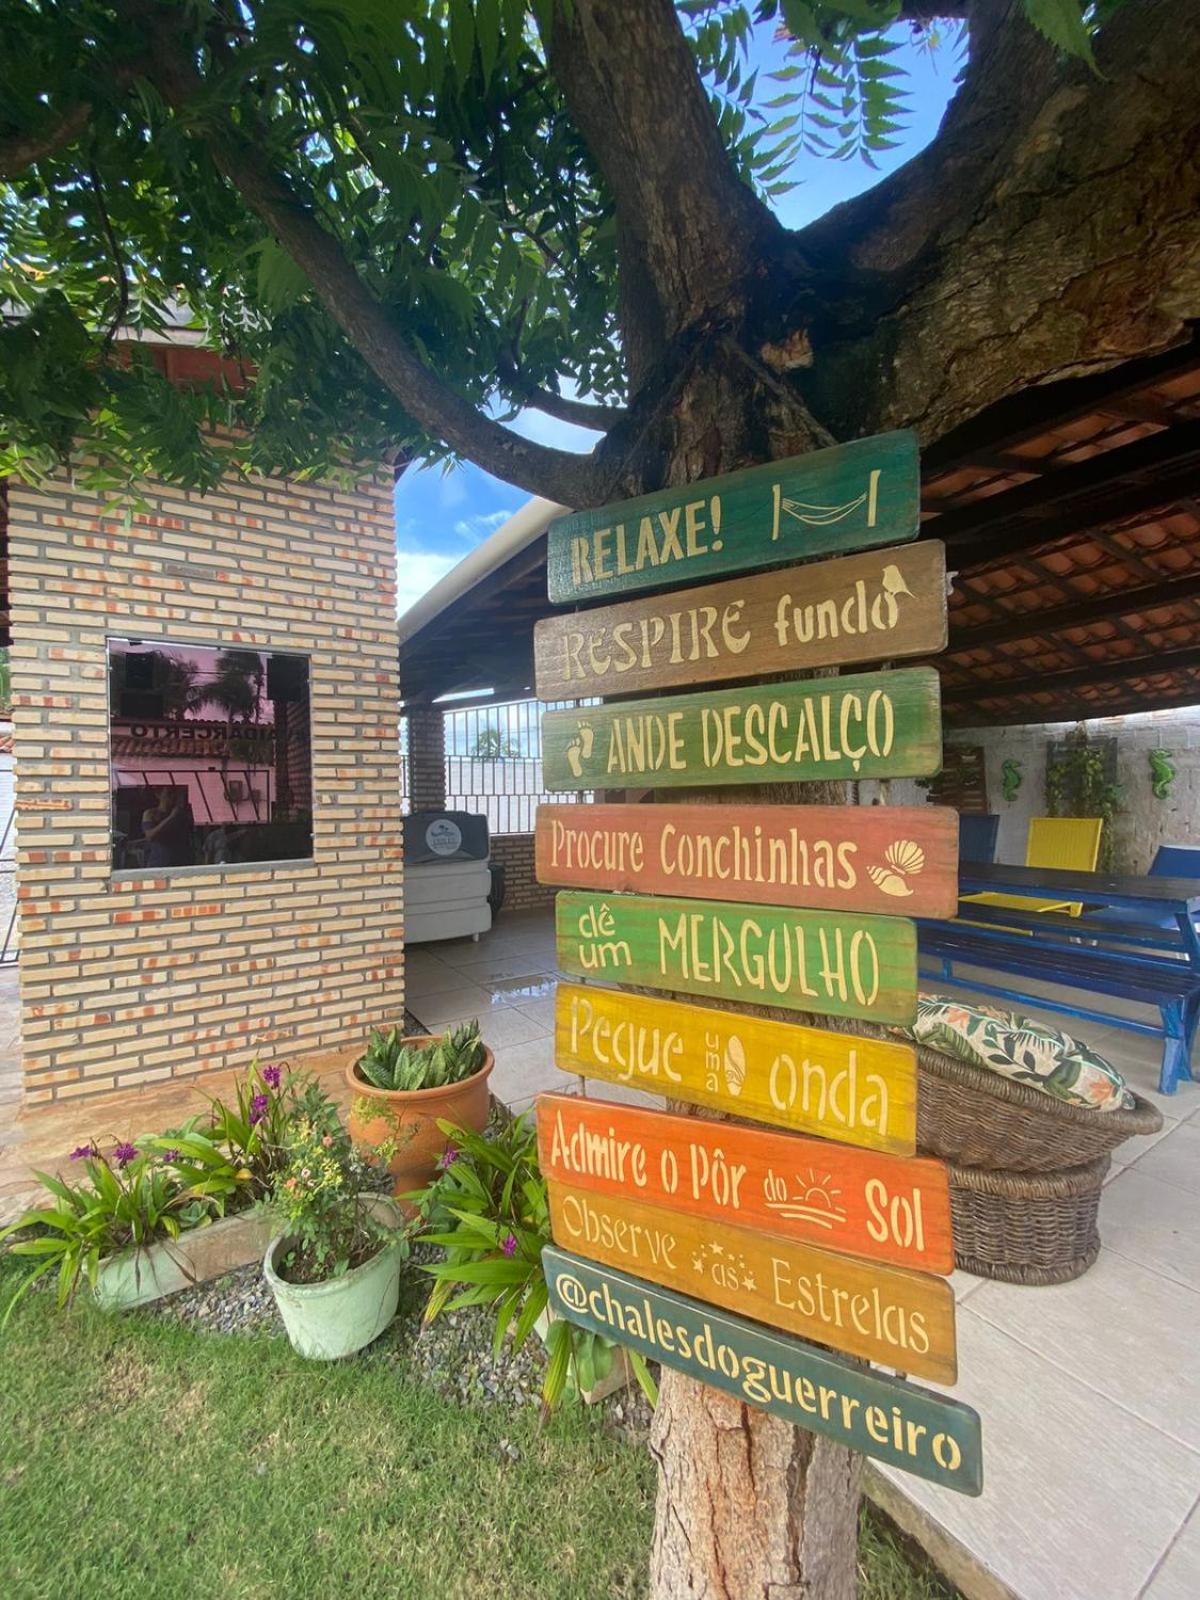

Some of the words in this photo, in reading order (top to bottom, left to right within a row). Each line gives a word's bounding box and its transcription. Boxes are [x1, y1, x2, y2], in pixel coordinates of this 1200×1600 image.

[571, 495, 724, 585] RELAXE!
[562, 600, 751, 681] RESPIRE
[774, 580, 899, 646] fundo
[607, 712, 687, 773] ANDE
[702, 690, 895, 771] DESCALÇO
[551, 820, 644, 872] Procure
[660, 824, 858, 890] Conchinhas
[579, 904, 615, 939] dê
[579, 940, 631, 968] um
[658, 913, 880, 1006] MERGULHO
[570, 996, 684, 1081] Pegue
[769, 1050, 889, 1136] onda
[551, 1110, 646, 1188] Admire
[660, 1149, 677, 1194] o
[690, 1143, 747, 1209] Pôr
[763, 1169, 788, 1202] do
[864, 1178, 925, 1251] Sol
[561, 1195, 677, 1269] Observe
[711, 1263, 739, 1291] as
[770, 1258, 930, 1354] Estrelas
[555, 1272, 962, 1470] @chalesdoguerreiro
